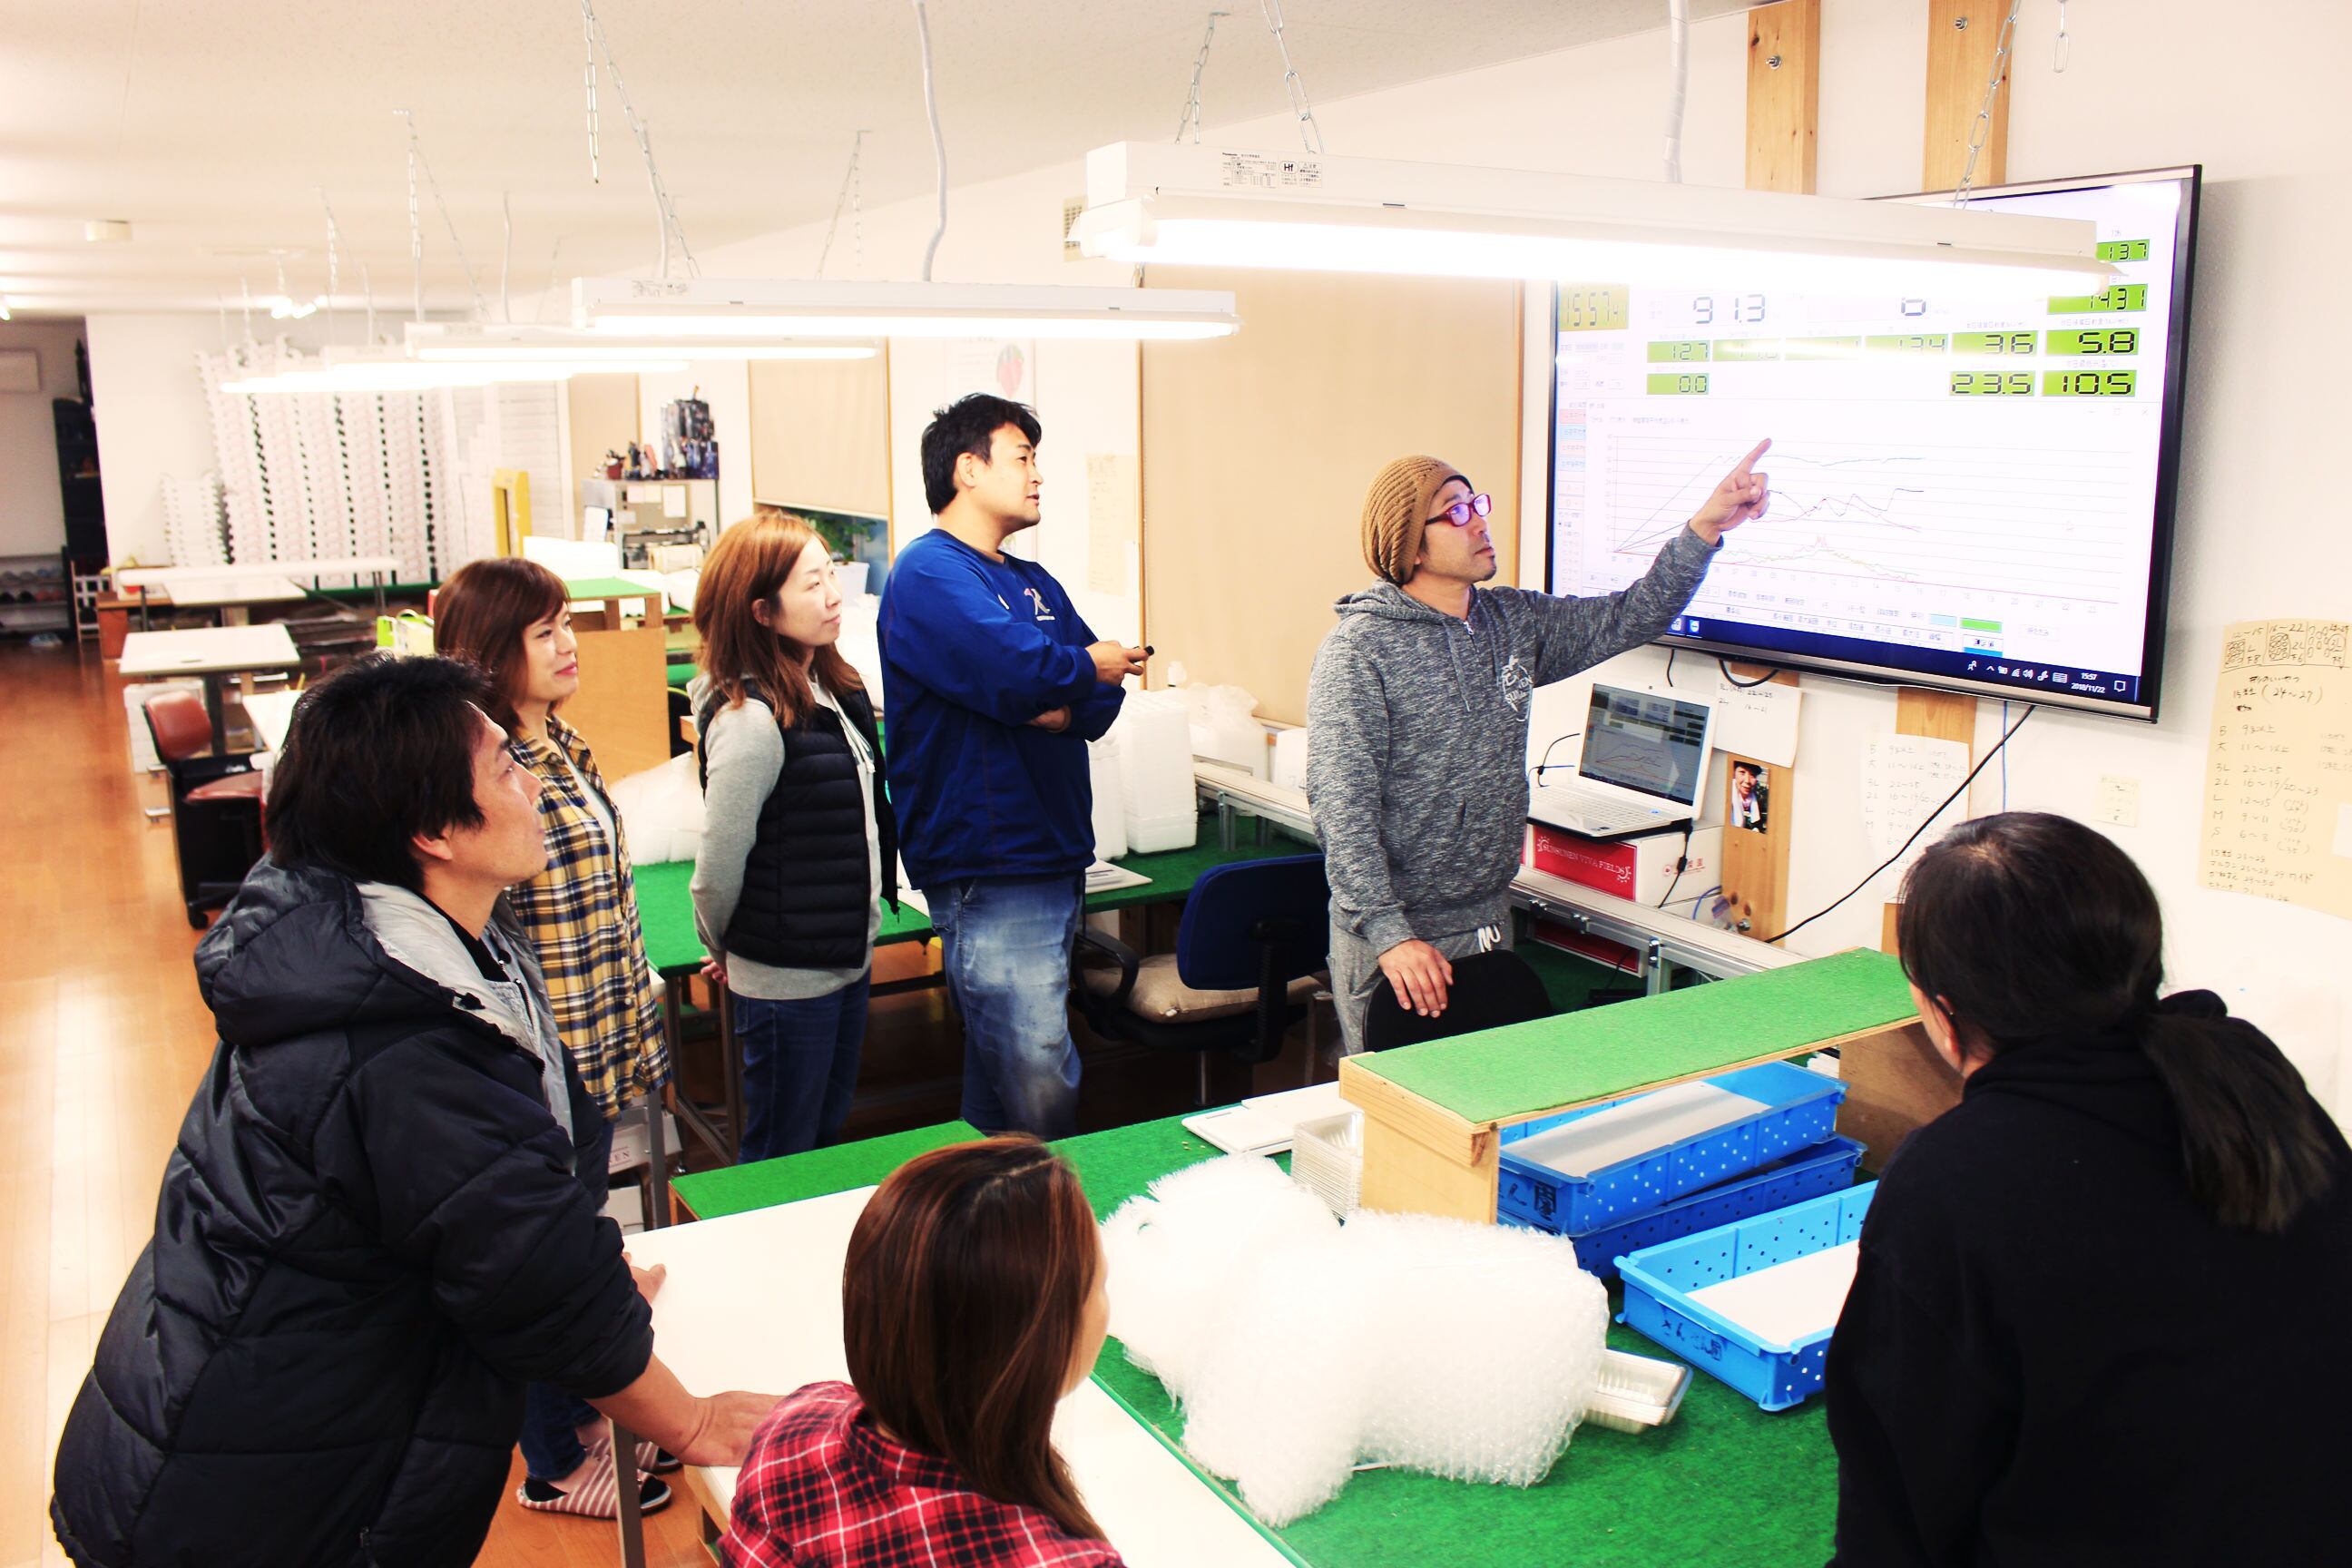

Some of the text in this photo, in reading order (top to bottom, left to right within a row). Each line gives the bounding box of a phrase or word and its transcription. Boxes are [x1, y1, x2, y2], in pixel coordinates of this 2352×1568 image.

[1283, 163, 1293, 172] Hf
[2079, 331, 2135, 354] 5.8
[1952, 374, 2032, 395] 23.5
[2063, 373, 2132, 395] 10.5
[2081, 672, 2098, 681] 15:57
[2071, 682, 2106, 694] 2018/11/22
[1599, 860, 1625, 875] FIELDS
